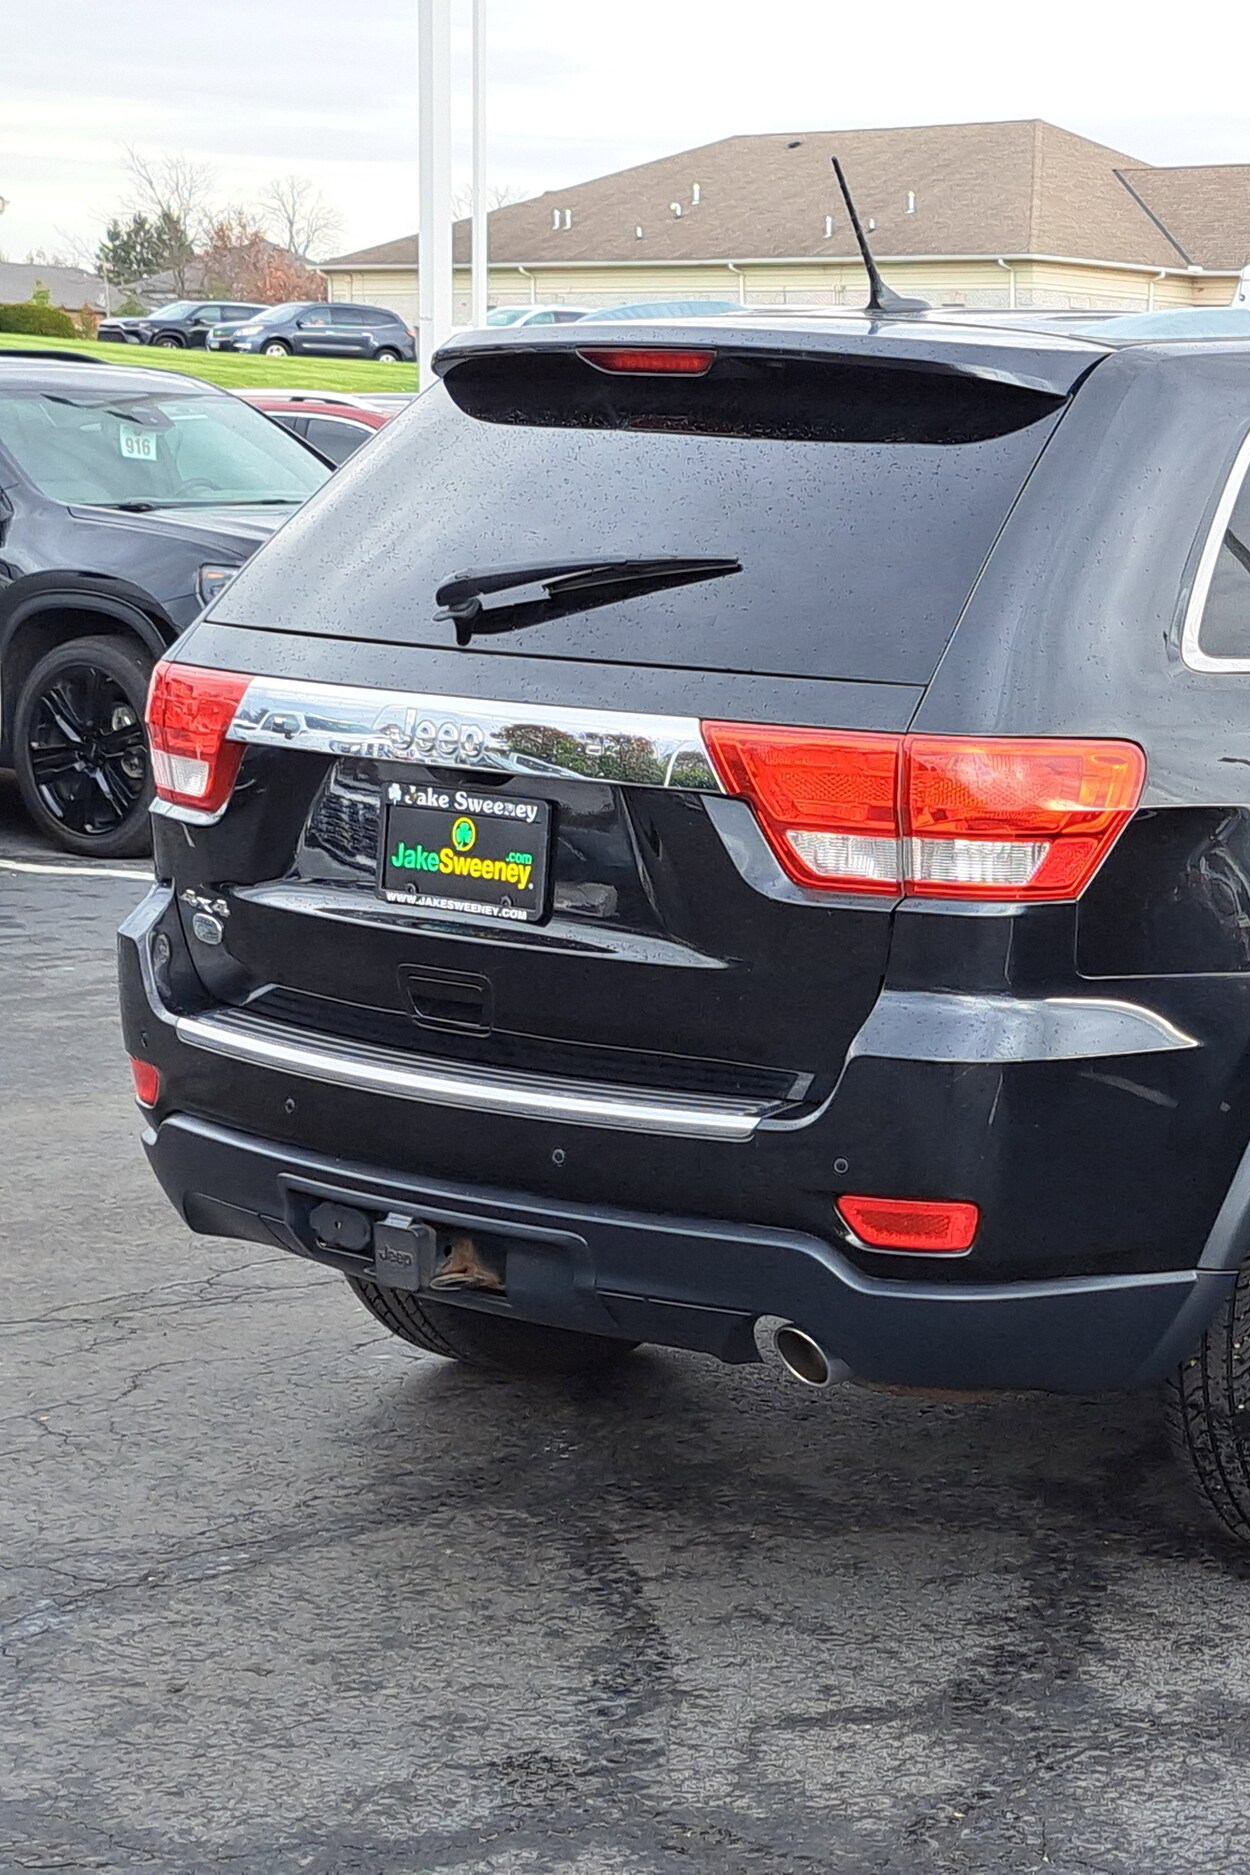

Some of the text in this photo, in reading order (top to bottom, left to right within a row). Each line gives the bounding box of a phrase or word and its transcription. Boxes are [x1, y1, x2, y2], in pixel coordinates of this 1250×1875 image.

[125, 437, 151, 456] 916
[387, 707, 485, 758] Jeep
[405, 785, 537, 823] Jake Sweeney
[379, 1245, 412, 1267] Jeep
